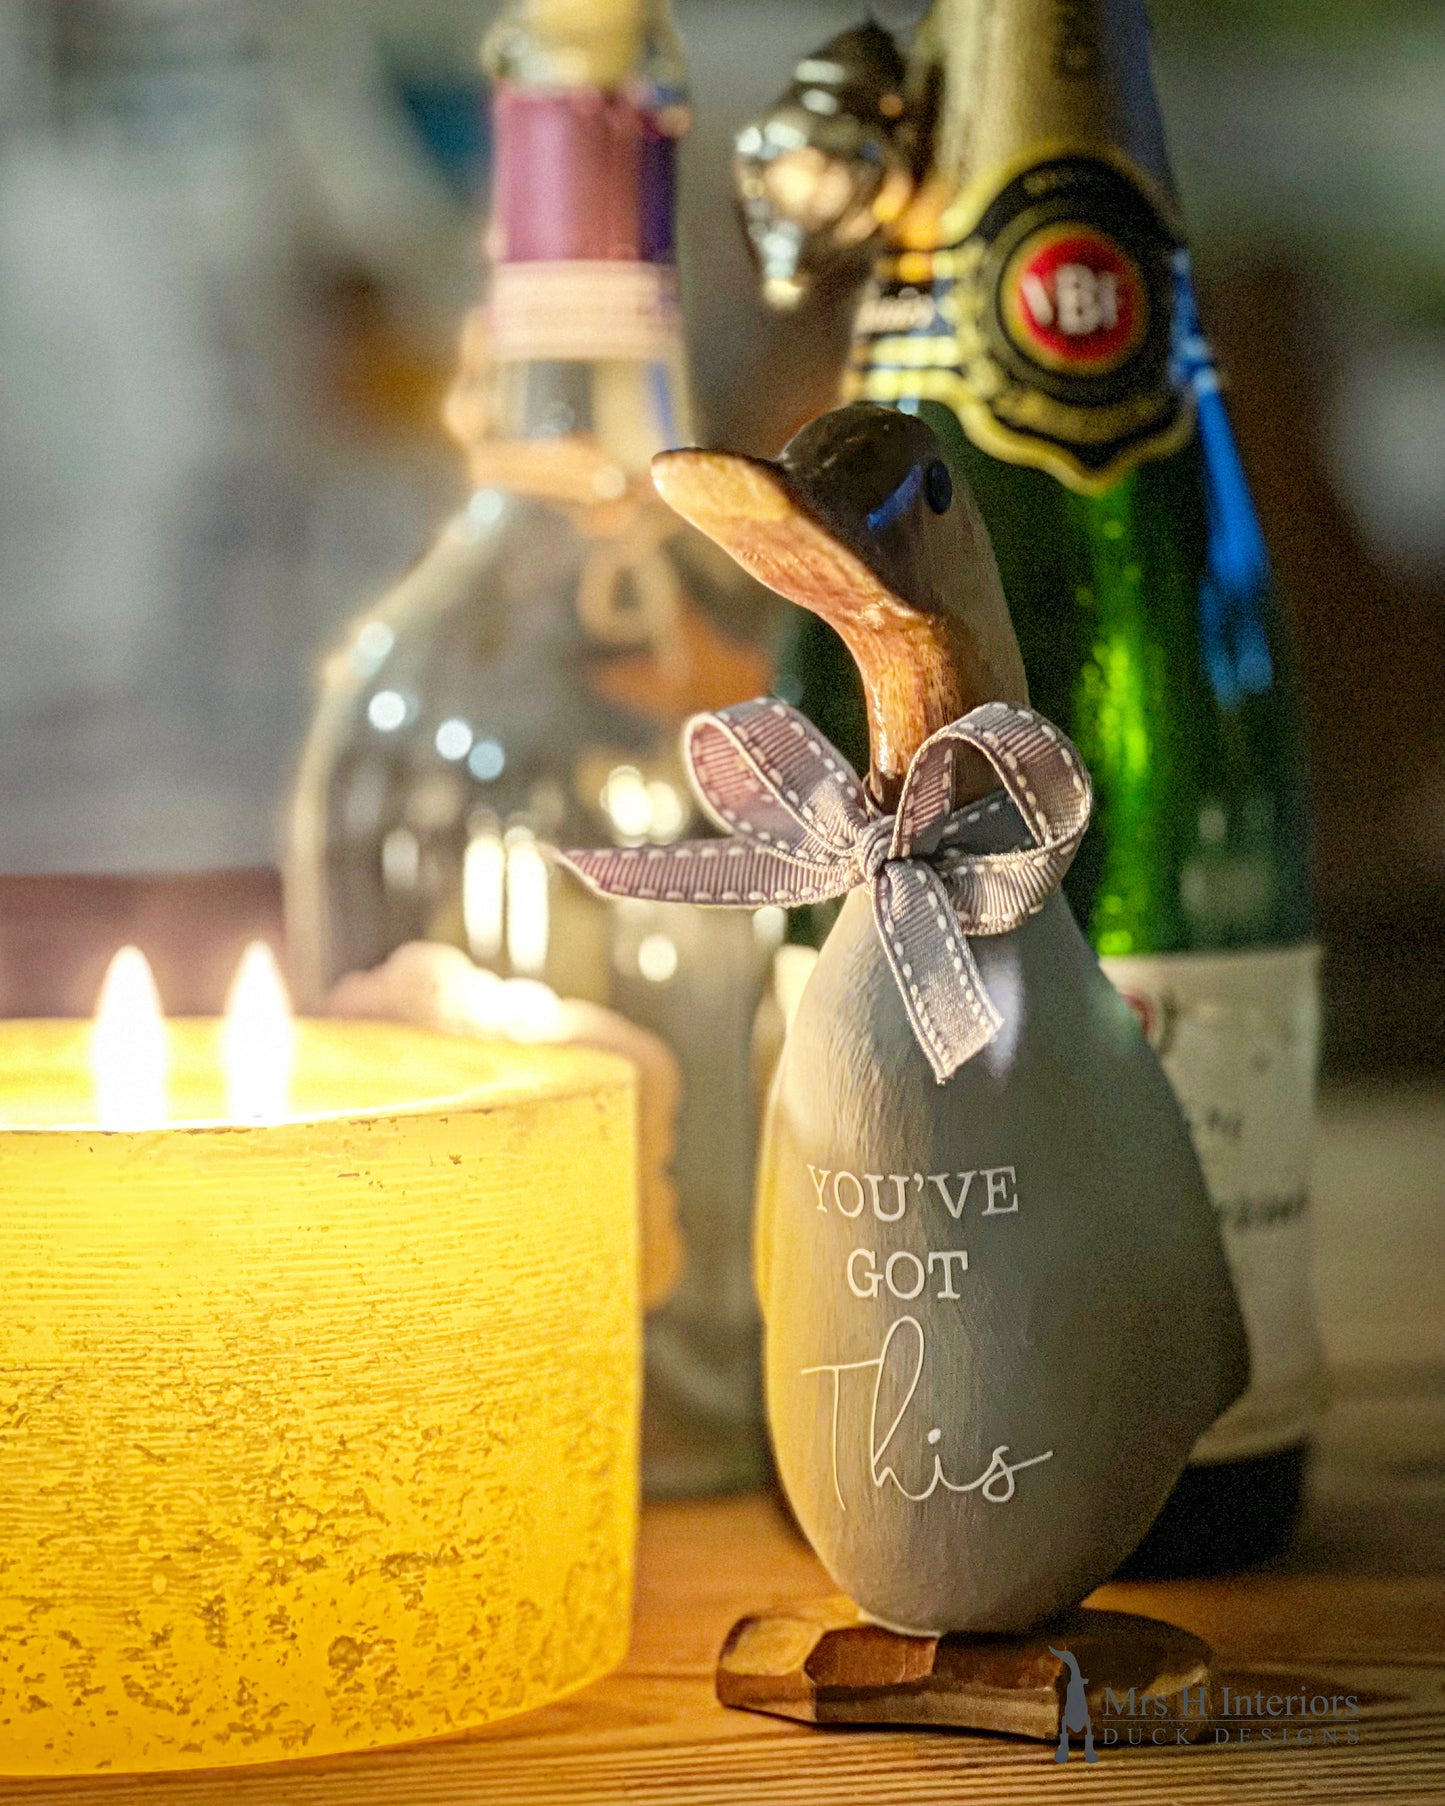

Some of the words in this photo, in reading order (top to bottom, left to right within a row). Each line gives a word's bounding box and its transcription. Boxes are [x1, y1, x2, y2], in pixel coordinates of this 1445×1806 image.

[807, 1164, 1019, 1221] YOU'VE
[847, 1248, 968, 1300] GOT
[801, 1315, 1054, 1511] This
